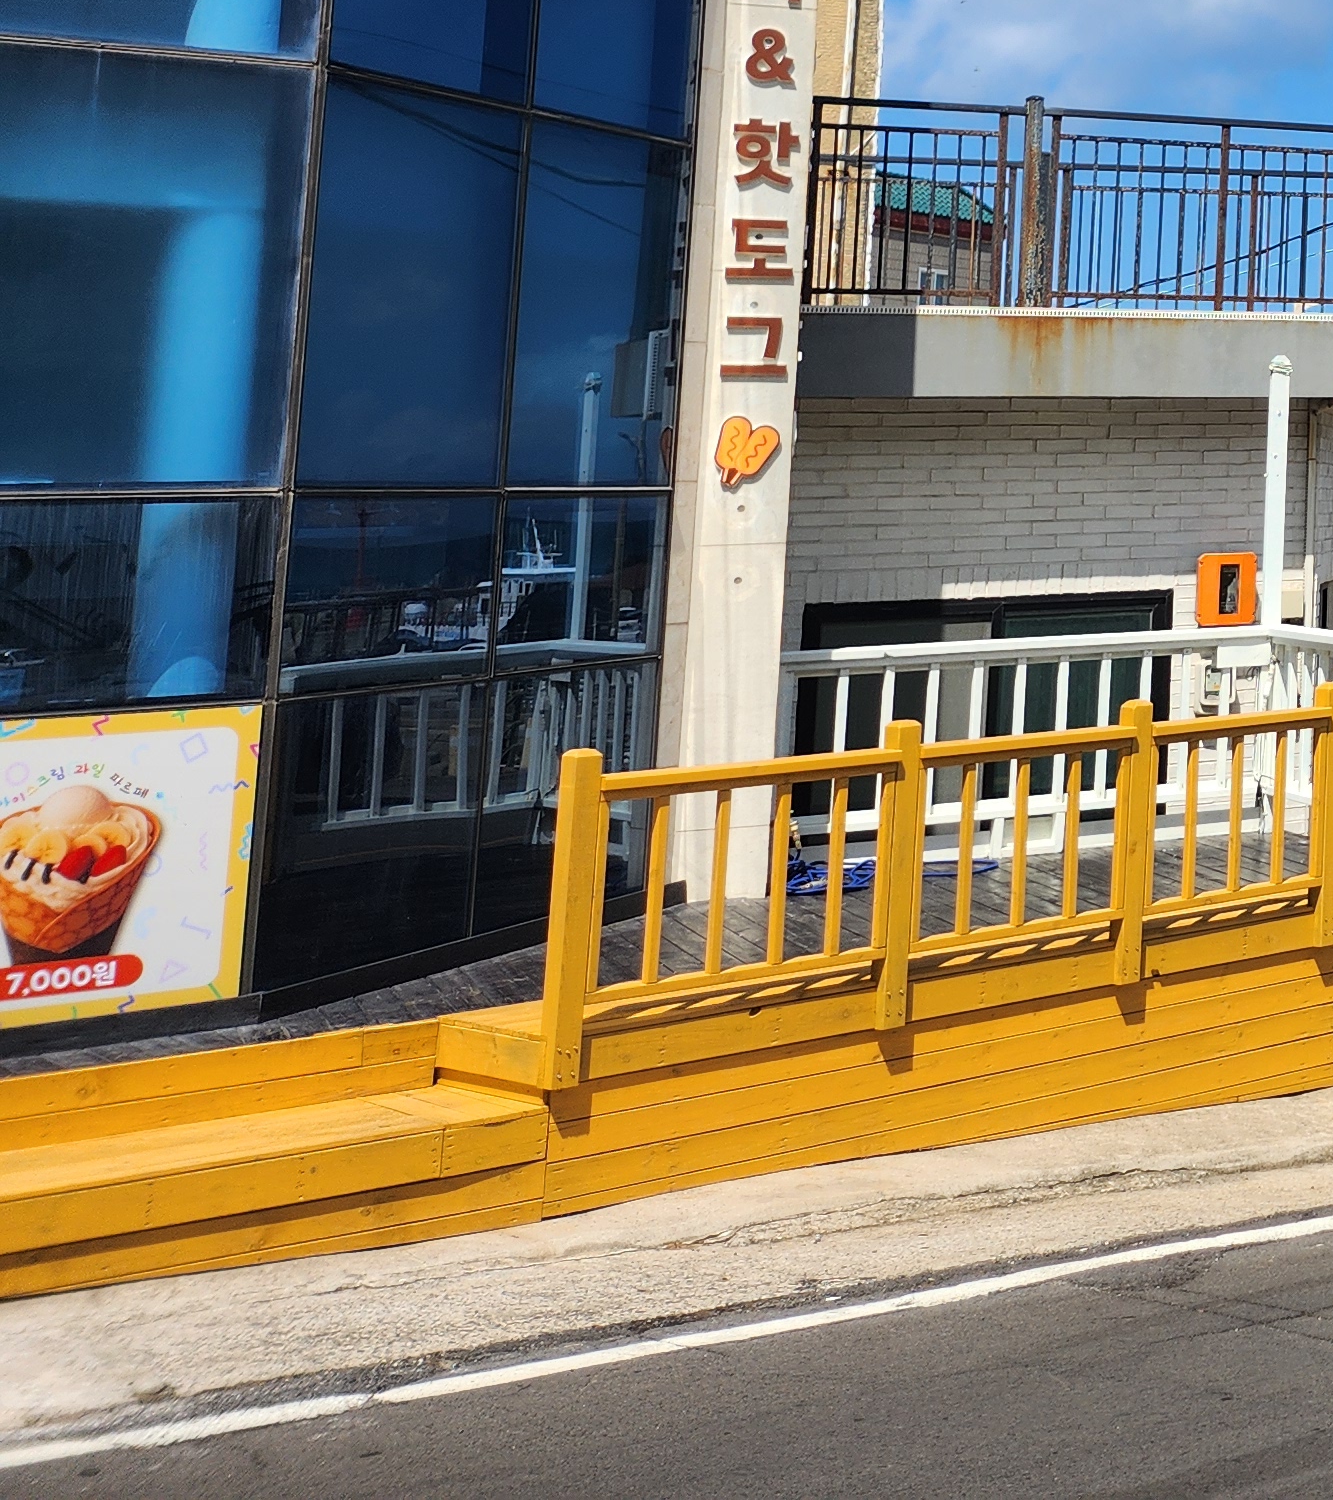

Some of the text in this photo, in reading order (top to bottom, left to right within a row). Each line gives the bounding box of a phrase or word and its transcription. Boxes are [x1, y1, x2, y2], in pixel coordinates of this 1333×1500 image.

[73, 762, 105, 779] 과일
[109, 772, 150, 799] 파르페
[5, 959, 118, 997] 7,000원
